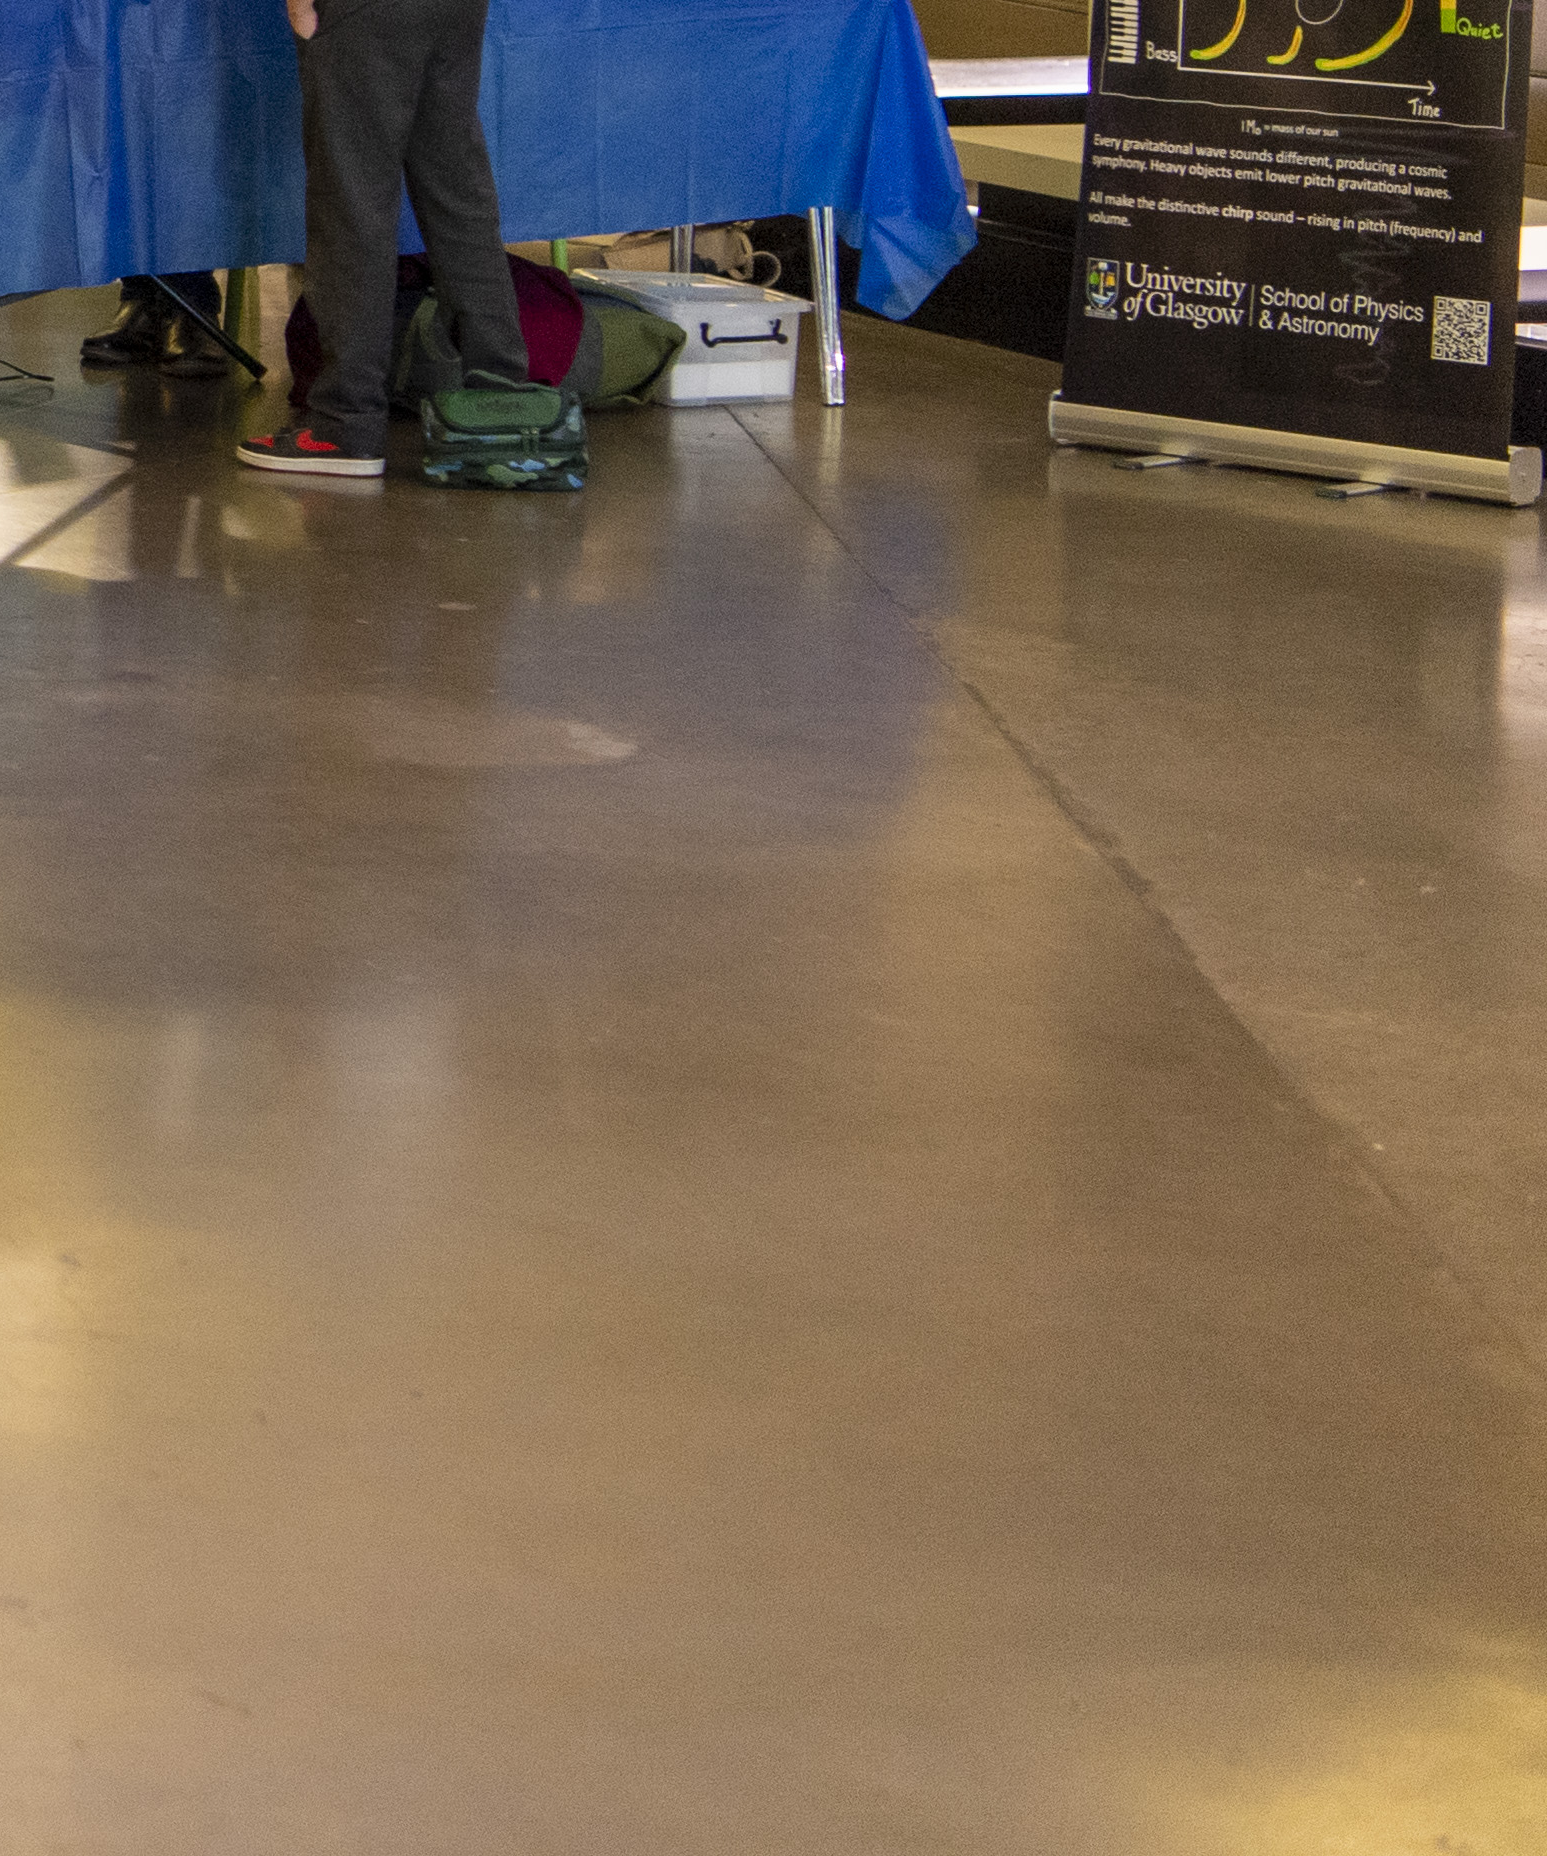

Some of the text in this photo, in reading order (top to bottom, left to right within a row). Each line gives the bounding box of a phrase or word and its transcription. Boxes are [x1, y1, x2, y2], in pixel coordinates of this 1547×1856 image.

[1455, 16, 1504, 40] Quiet
[1145, 40, 1178, 63] Bass
[1408, 97, 1441, 118] Time
[1271, 125, 1339, 137] mass of our sun
[1093, 133, 1449, 179] Every gravitational wave sounds different, producing a cosmic
[1092, 154, 1452, 200] symphony. Heavy objects emit lower pitch gravitational waves.
[1087, 211, 1132, 227] volume.
[1089, 191, 1484, 244] All make the distinctive chirp sound rising in pitch (frequency) and
[1124, 260, 1425, 323] University School of Physics
[1122, 289, 1381, 346] of Glasgow & Astronomy
